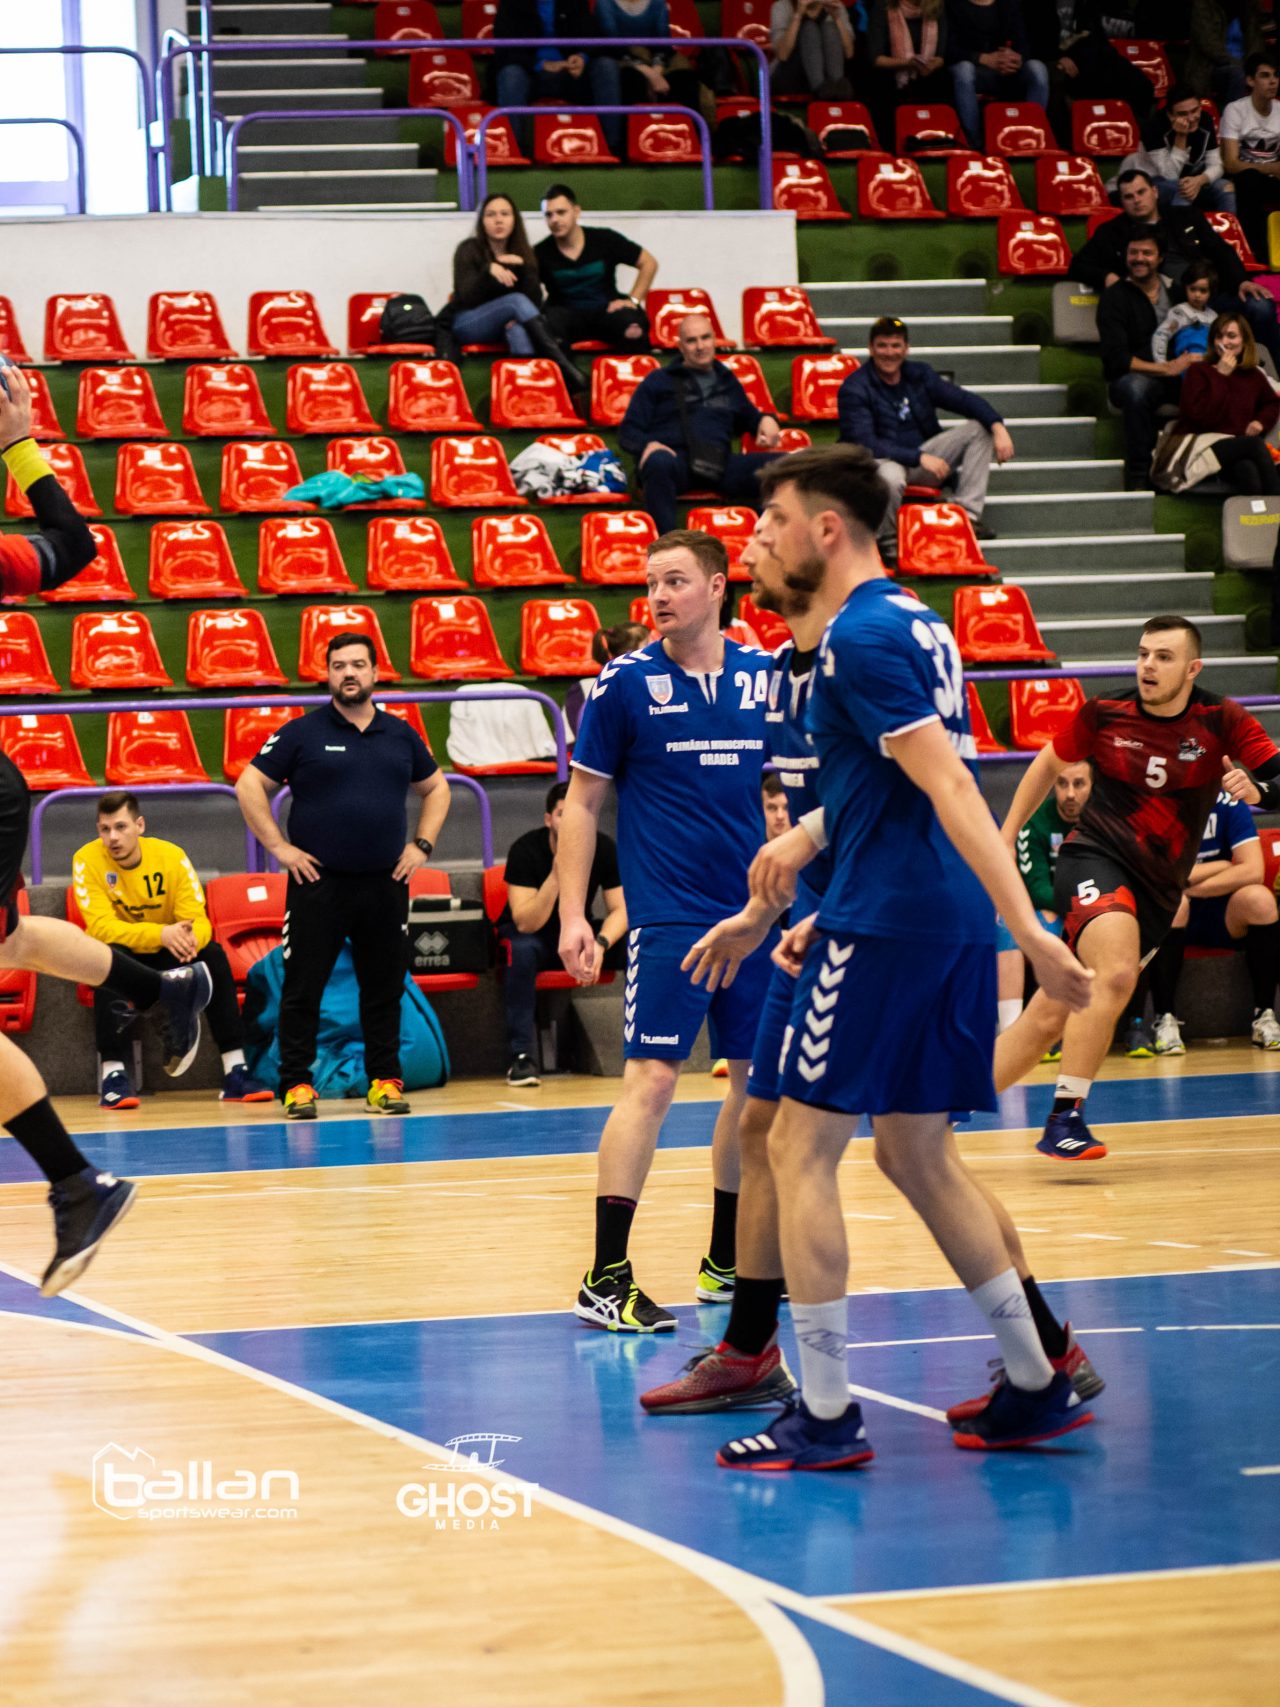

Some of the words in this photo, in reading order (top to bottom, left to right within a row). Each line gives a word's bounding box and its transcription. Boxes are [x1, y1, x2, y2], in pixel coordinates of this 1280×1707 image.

[734, 670, 768, 710] 24
[1145, 755, 1168, 789] 5
[143, 872, 166, 898] 12
[1077, 879, 1100, 906] 5
[640, 1033, 679, 1045] hummel
